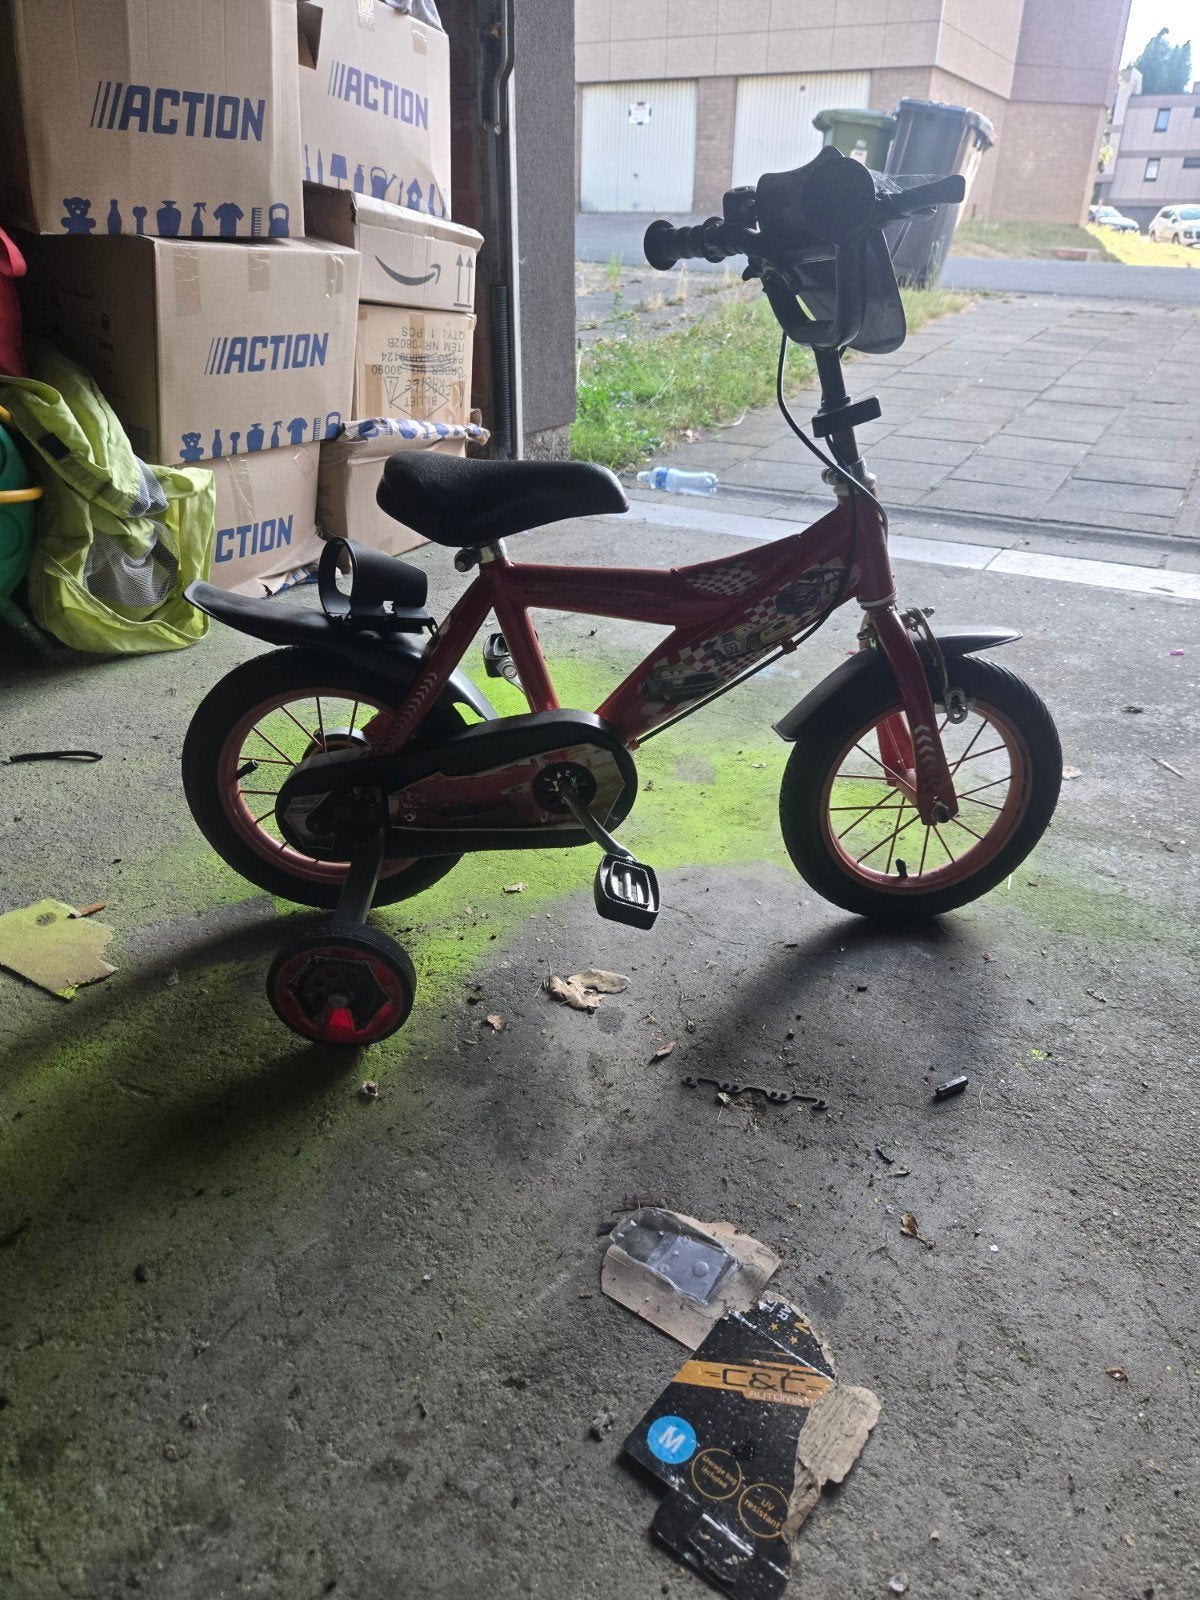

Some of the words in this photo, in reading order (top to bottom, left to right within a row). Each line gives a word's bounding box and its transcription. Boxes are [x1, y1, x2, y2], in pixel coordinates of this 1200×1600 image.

[118, 85, 266, 142] ACTION
[344, 66, 428, 131] ACTION
[401, 327, 423, 337] PCS
[443, 342, 464, 352] ITEM
[223, 332, 329, 374] ACTION
[215, 514, 293, 563] CTION
[659, 1425, 686, 1453] M
[743, 1499, 781, 1529] resistant
[760, 1498, 776, 1512] UV
